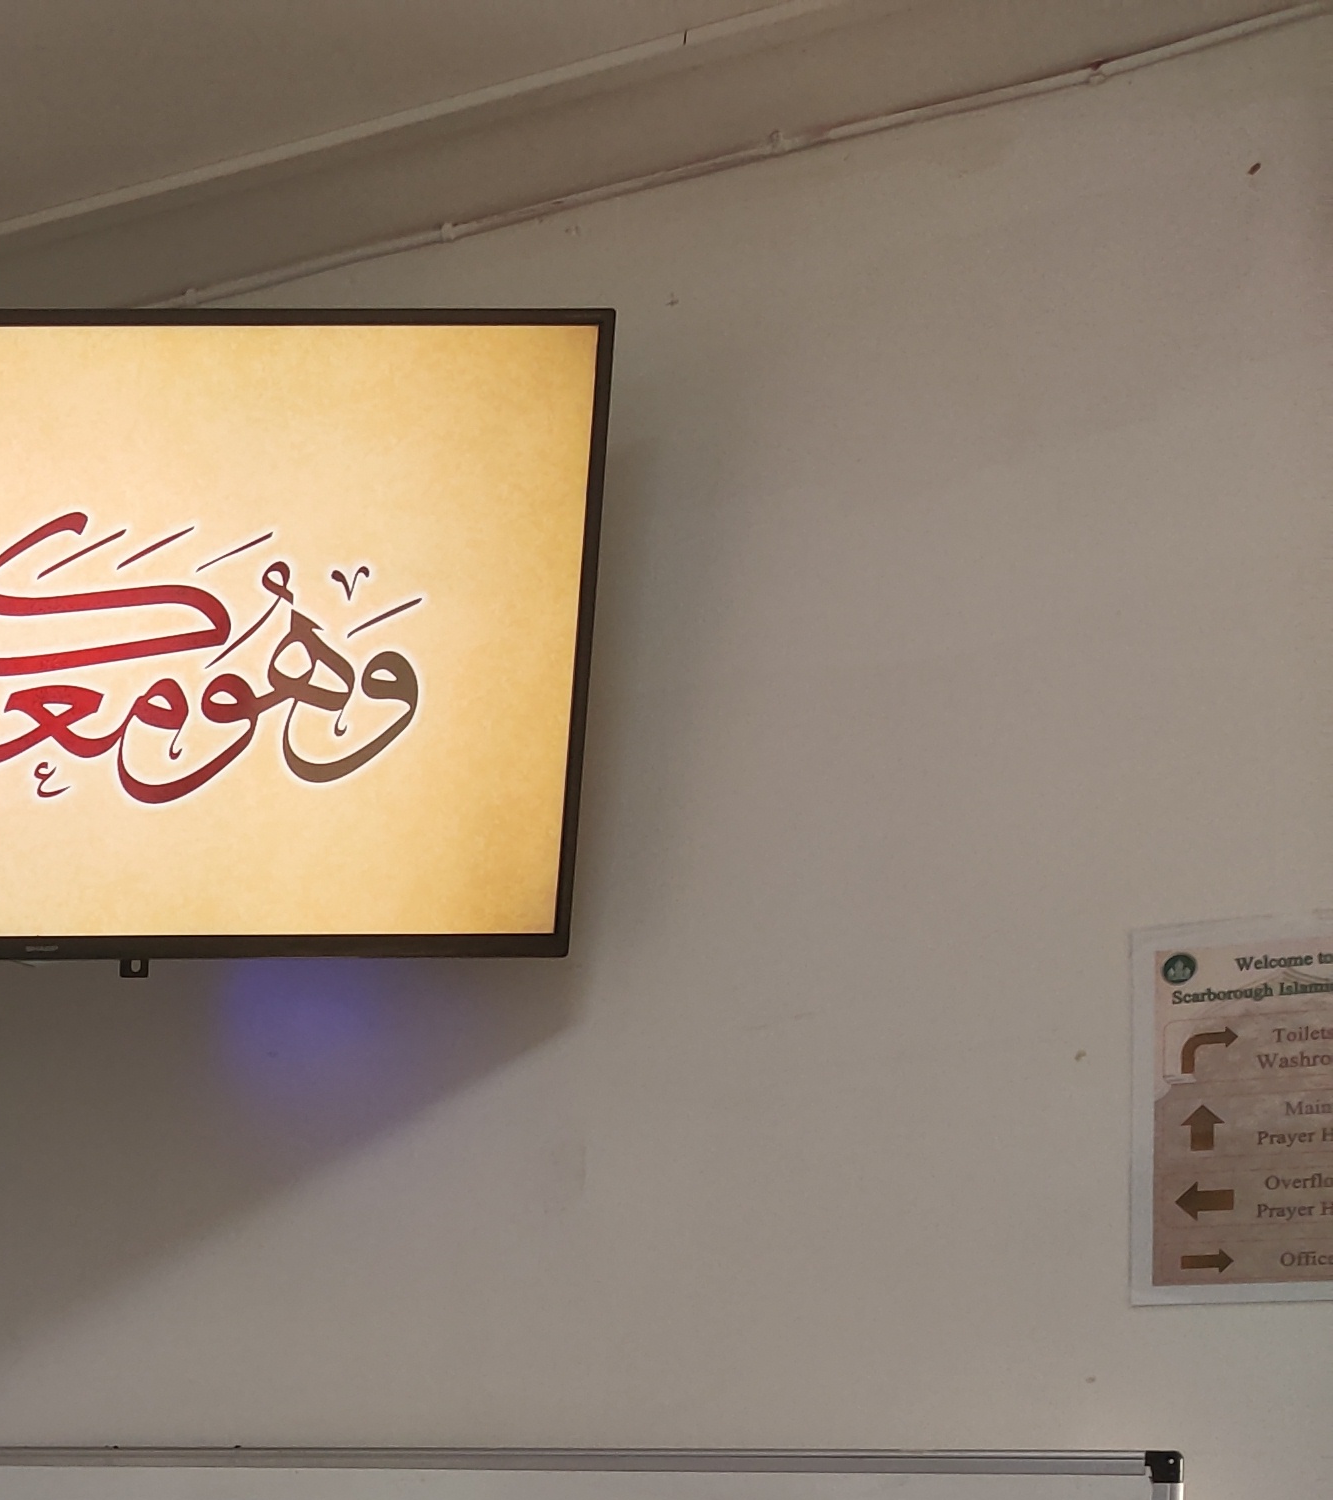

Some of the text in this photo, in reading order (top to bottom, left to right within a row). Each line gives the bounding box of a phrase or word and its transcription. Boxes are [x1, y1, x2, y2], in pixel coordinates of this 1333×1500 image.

[1235, 952, 1313, 972] Welcome
[1172, 982, 1273, 1005] Scarborough
[1285, 1099, 1332, 1116] Main
[1257, 1130, 1315, 1147] Prayer
[1256, 1203, 1315, 1221] Prayer
